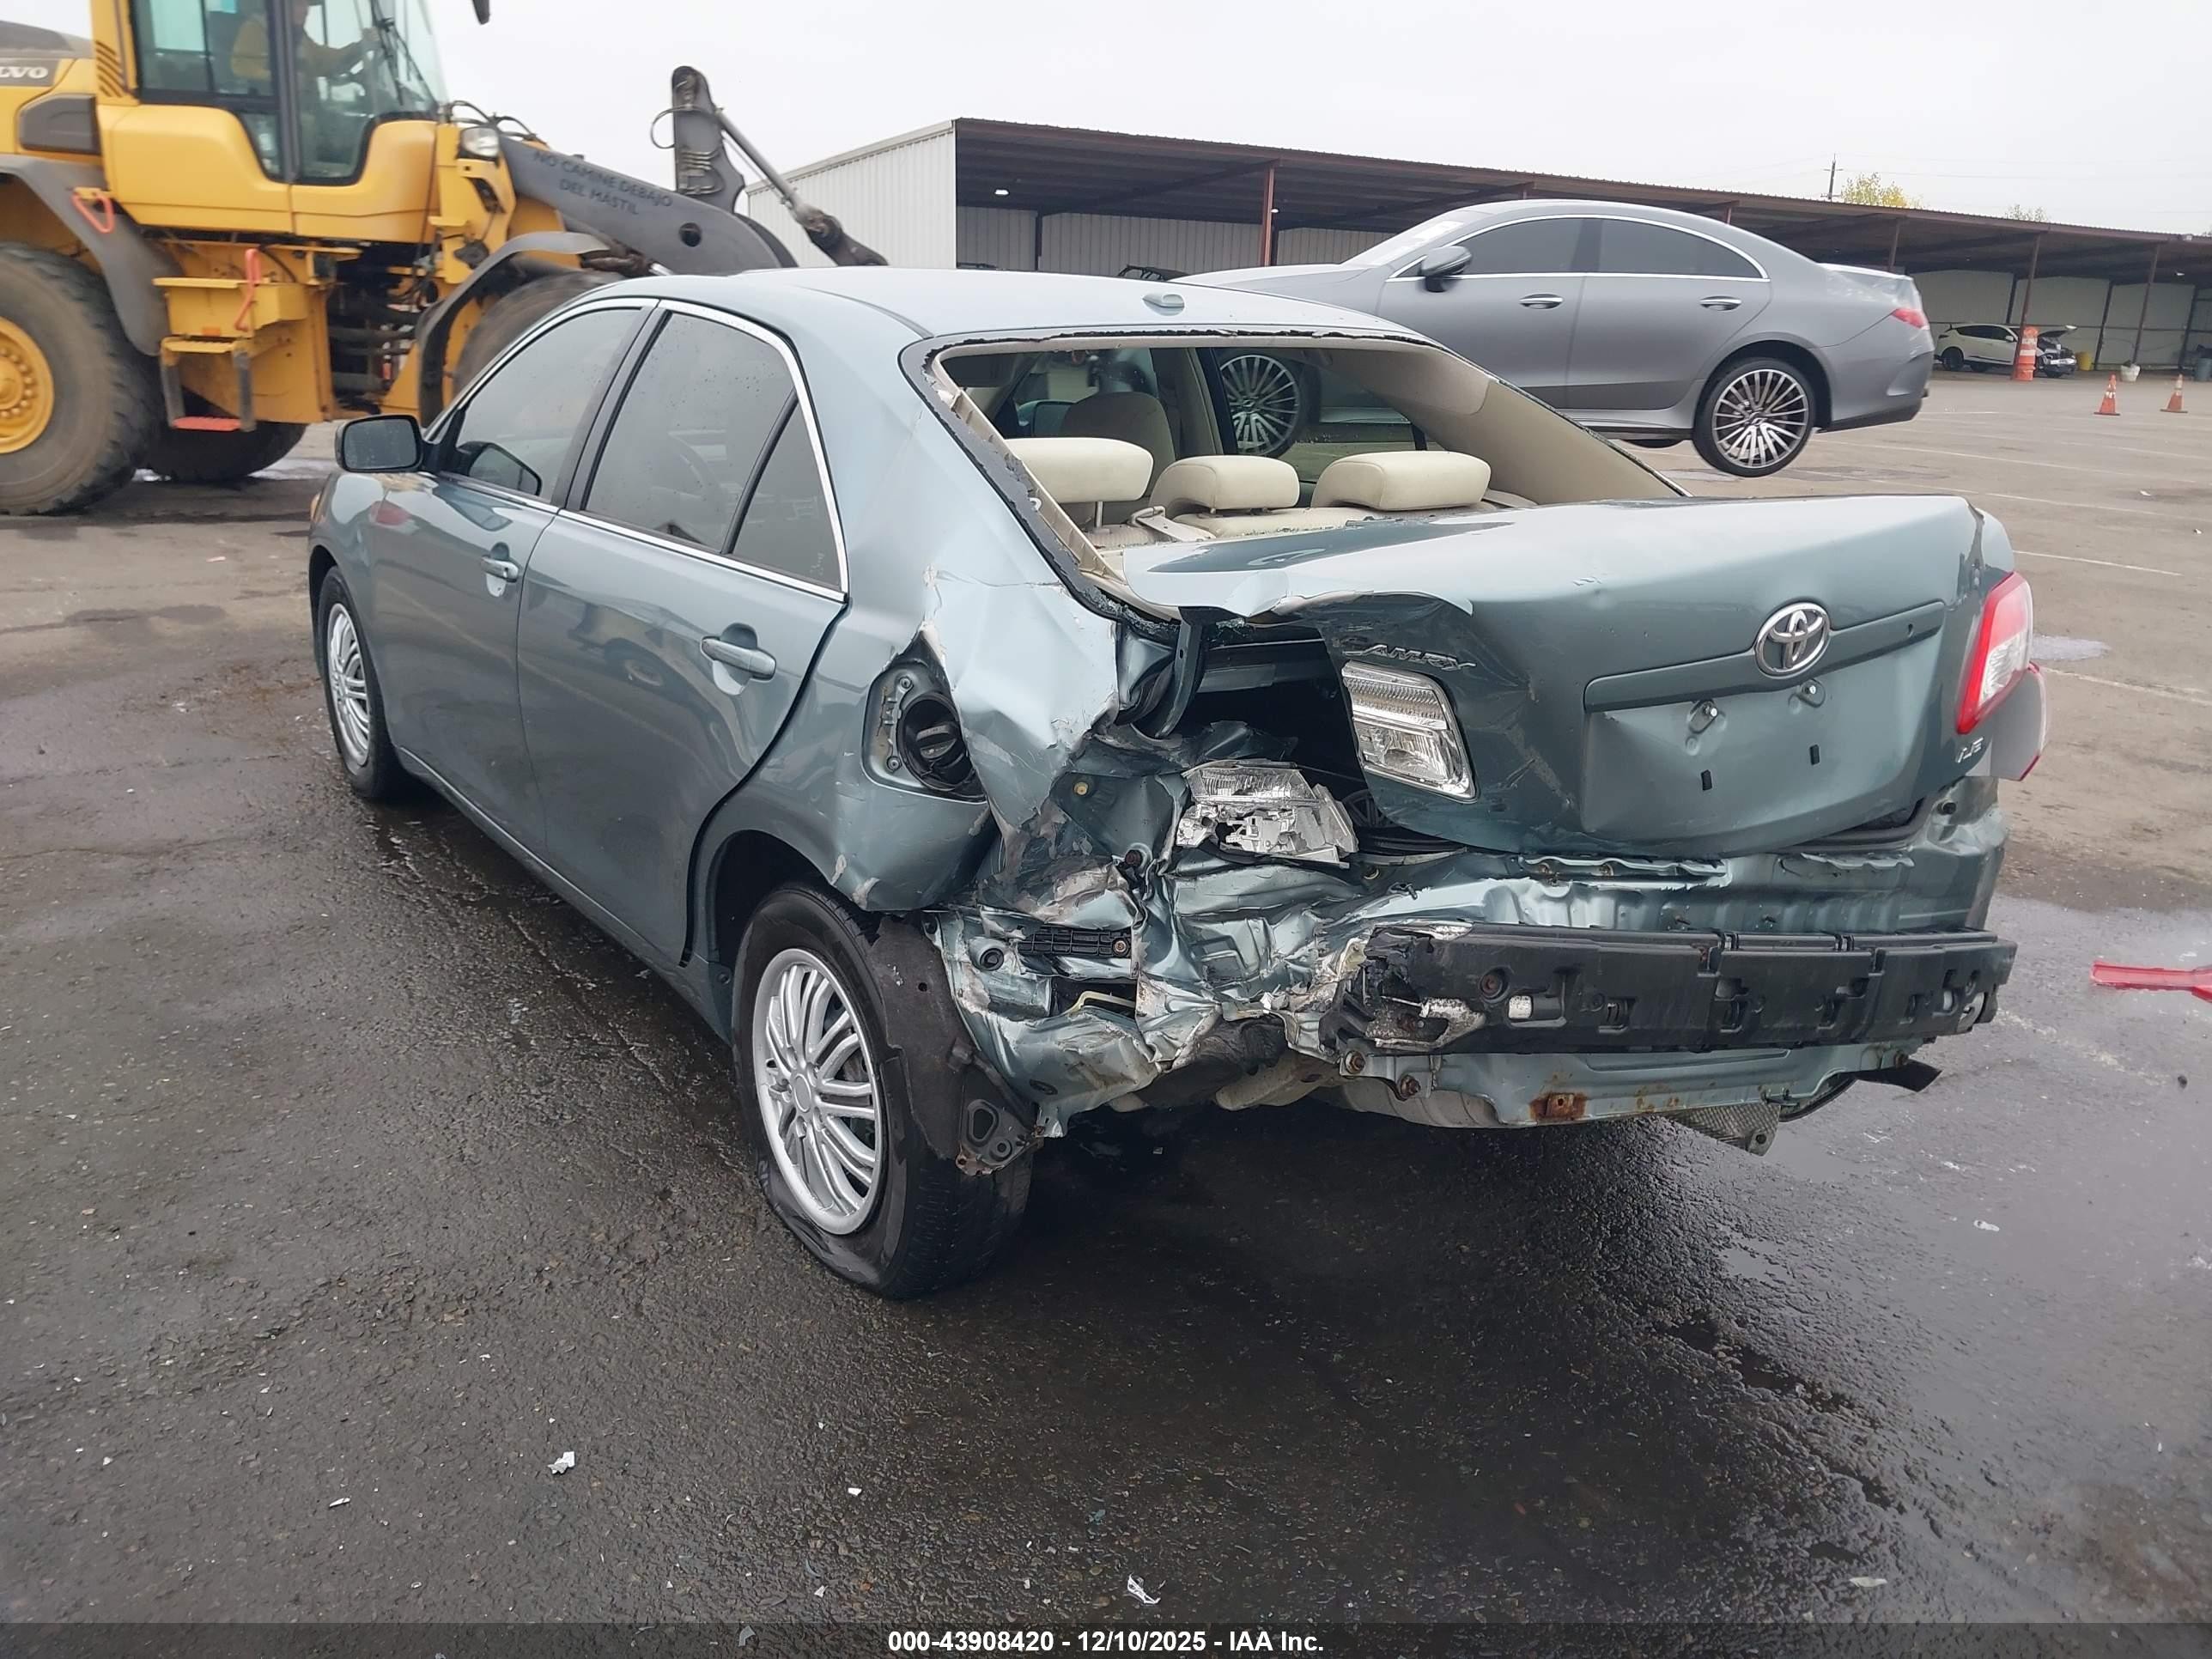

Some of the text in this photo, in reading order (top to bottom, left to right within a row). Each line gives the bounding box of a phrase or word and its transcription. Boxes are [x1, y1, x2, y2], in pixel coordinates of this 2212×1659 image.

[0, 66, 49, 78] LVO
[533, 150, 557, 167] NO
[559, 179, 585, 197] DEL
